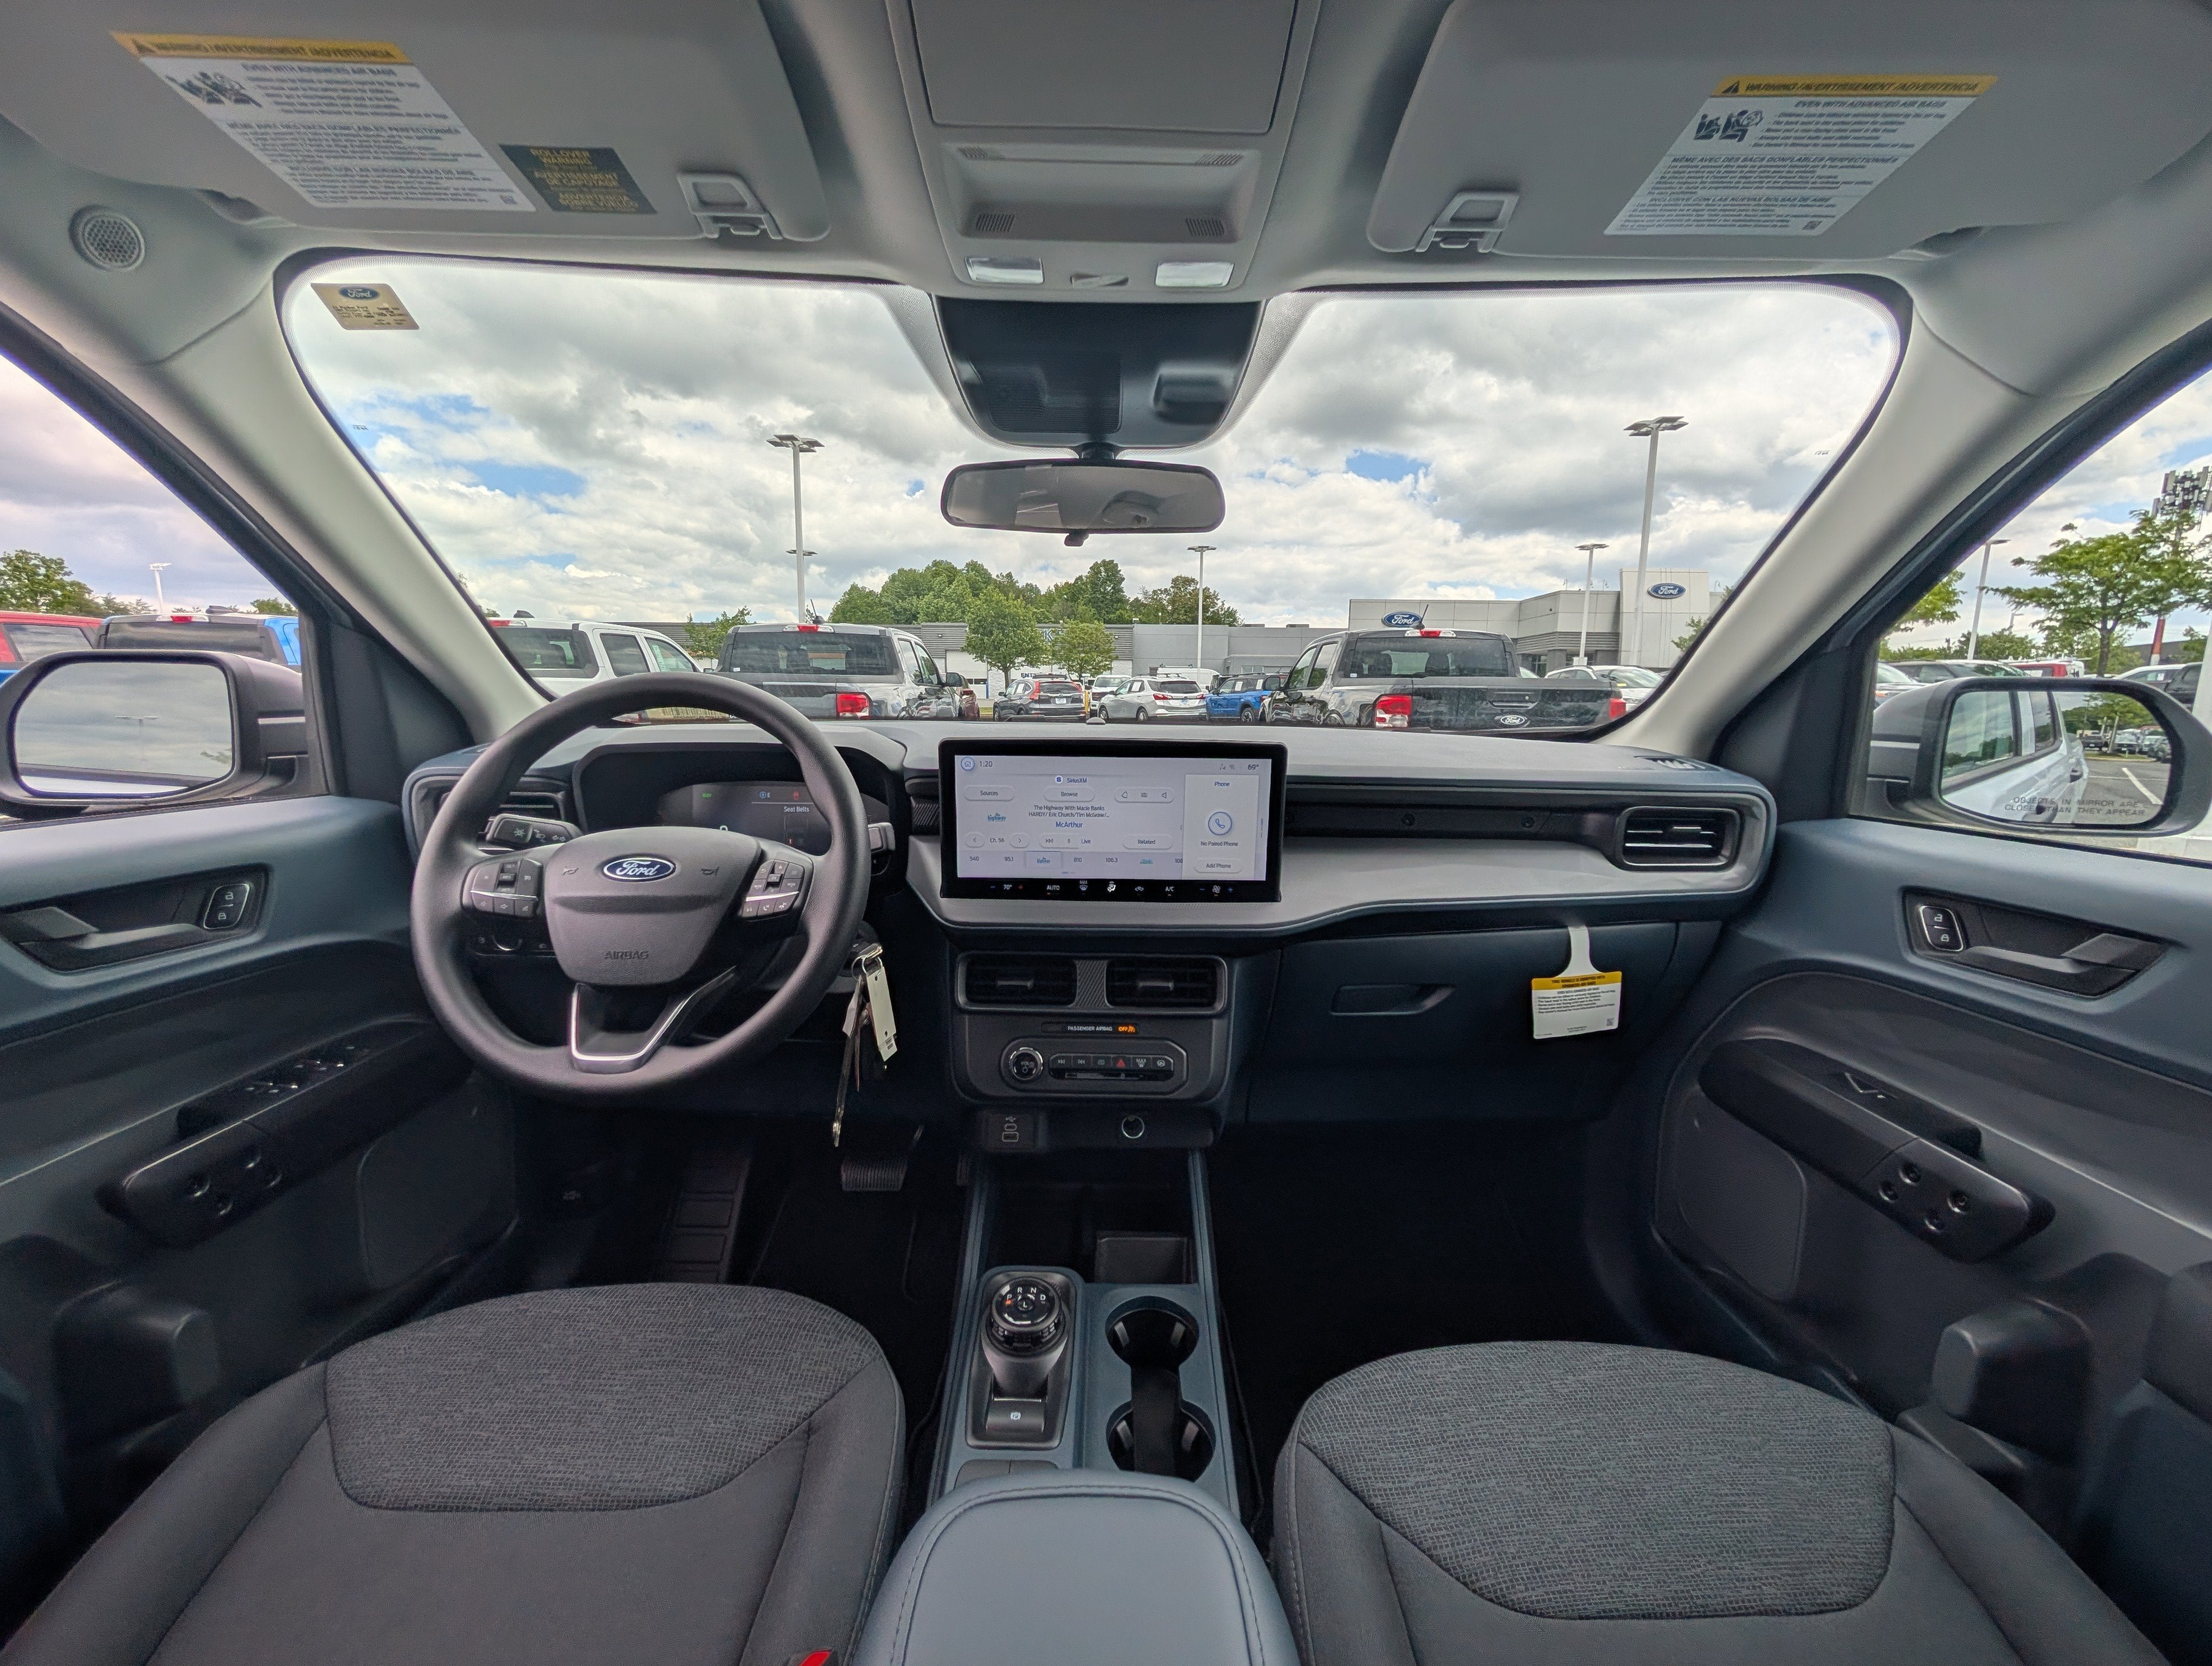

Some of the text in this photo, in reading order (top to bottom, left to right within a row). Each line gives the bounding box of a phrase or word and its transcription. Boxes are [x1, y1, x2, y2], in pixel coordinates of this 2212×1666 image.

[1658, 586, 1679, 594] Ford
[1391, 614, 1414, 624] Ford
[2014, 797, 2057, 805] OBJECTS
[616, 860, 661, 875] Ford
[604, 951, 649, 960] AIRBAG
